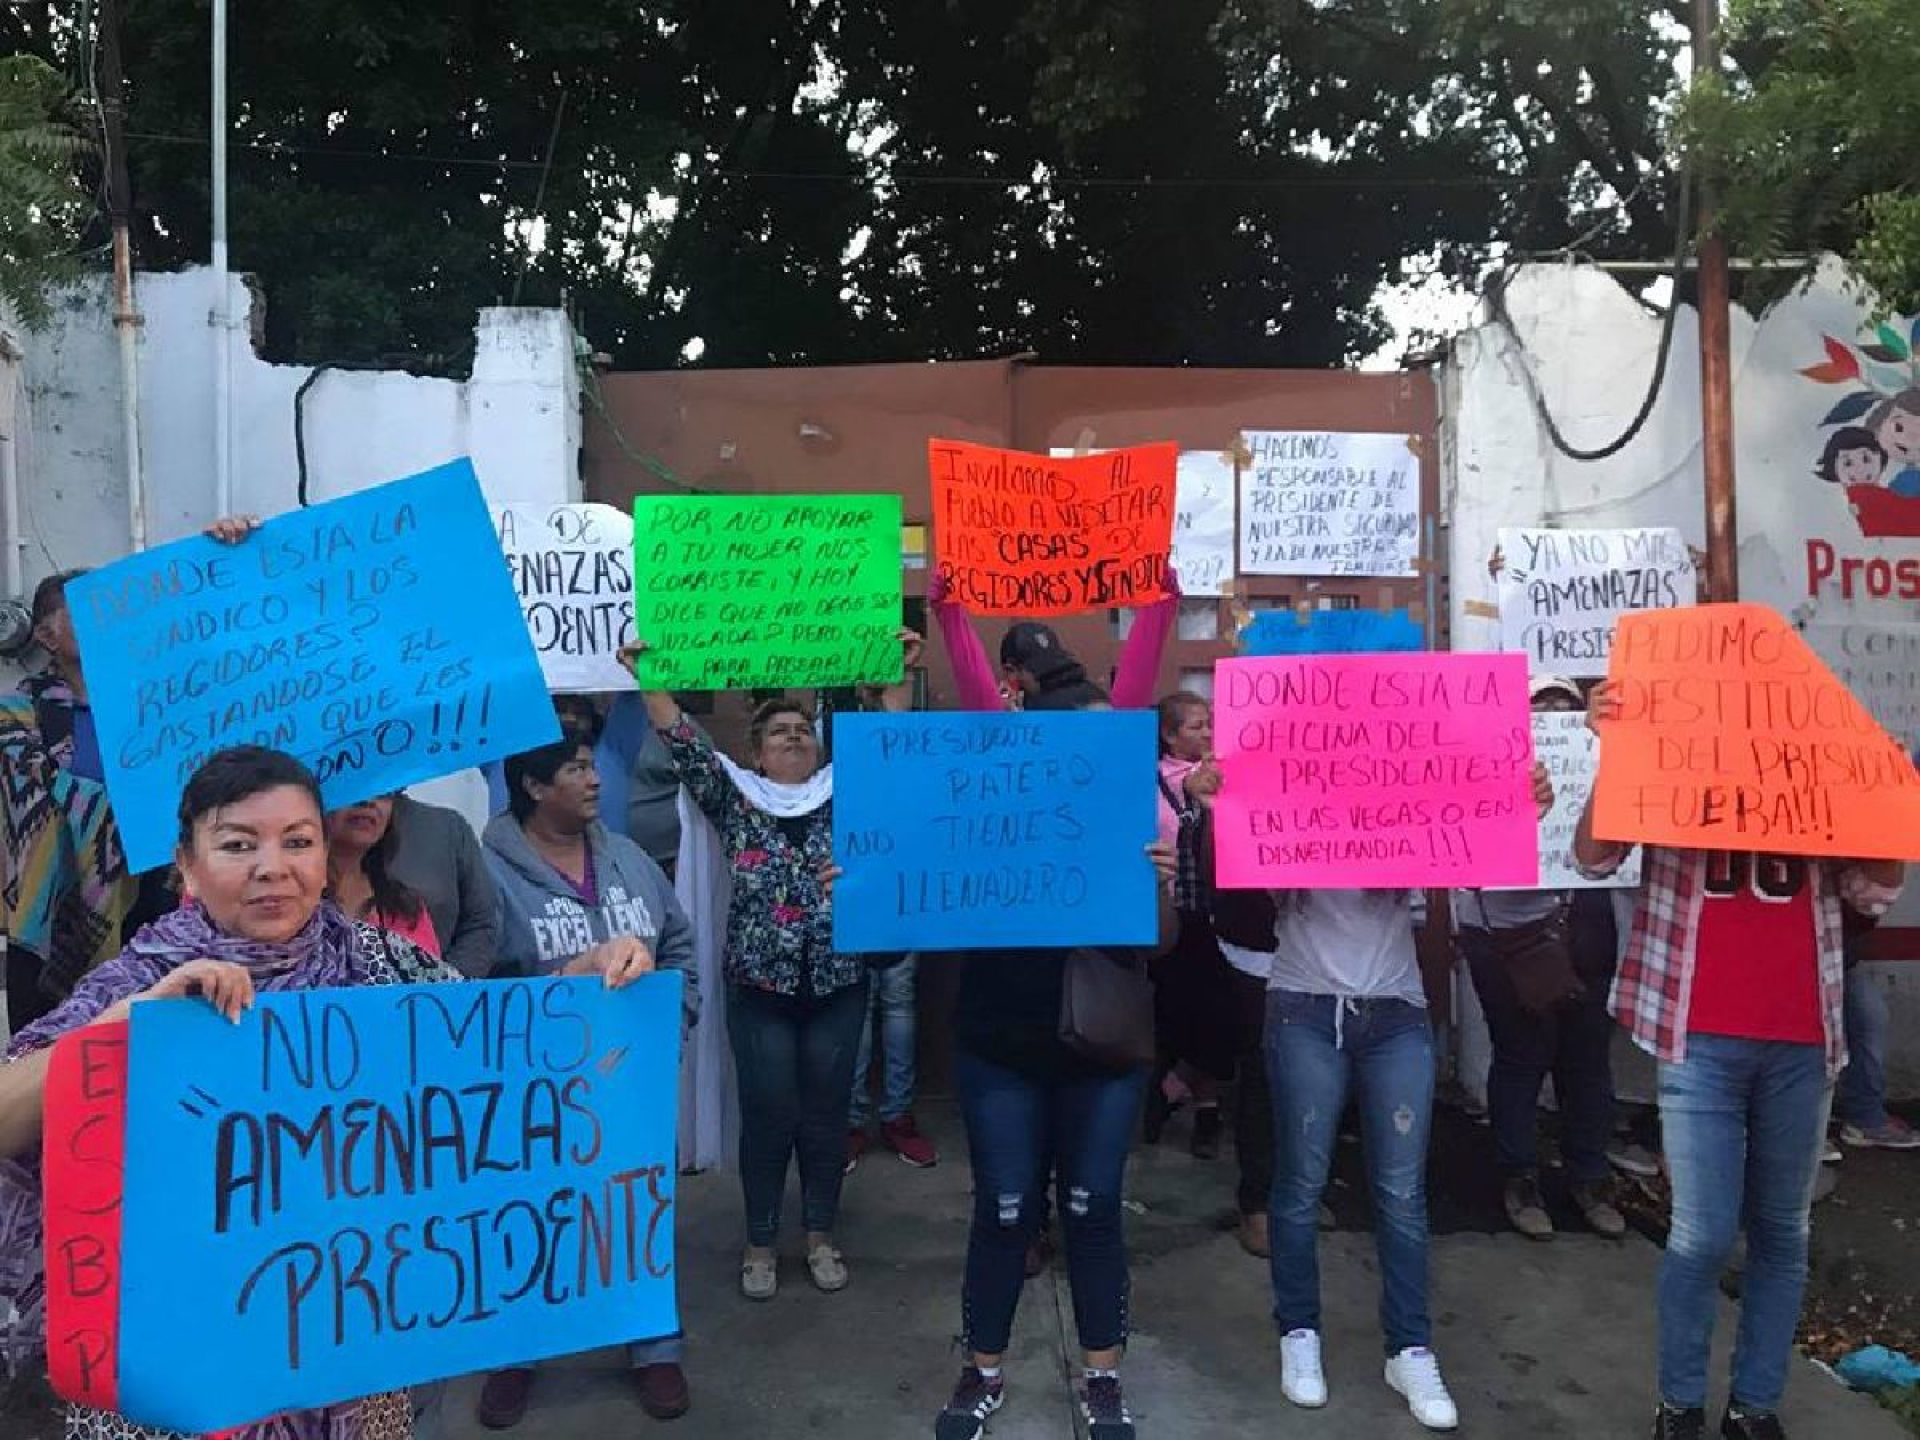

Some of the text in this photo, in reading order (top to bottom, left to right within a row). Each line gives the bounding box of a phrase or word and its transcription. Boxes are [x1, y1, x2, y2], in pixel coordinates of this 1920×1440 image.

[1253, 434, 1339, 460] HACEMOS
[1390, 470, 1408, 490] AL
[651, 503, 874, 534] POR NO APOYAR
[1030, 500, 1046, 528] A
[1250, 489, 1394, 513] PRESIDENTE DE
[371, 503, 417, 545] LA
[547, 506, 602, 545] DE
[1107, 526, 1147, 554] DE
[1249, 514, 1331, 542] NUESTRA
[652, 536, 871, 564] A TU MUJER NOS
[1522, 533, 1560, 570] YA
[1568, 533, 1609, 565] NO
[306, 577, 327, 616] Y
[348, 556, 419, 602] LOS
[808, 563, 858, 592] HOY
[652, 600, 708, 624] DICE
[719, 602, 768, 624] QUE
[774, 599, 807, 620] NO
[792, 624, 842, 646] PERO
[851, 623, 890, 642] QUE
[1229, 664, 1351, 710] DONDE
[1464, 671, 1503, 706] LA
[874, 724, 1044, 761] PRESIDENTE
[1238, 719, 1465, 752] OFICINA DEL
[1659, 735, 1728, 776] DEL
[846, 803, 1085, 856] NO TIENES
[1250, 798, 1513, 836] EN LAS VEGAS O EN
[897, 862, 1088, 917] LLENADERO
[260, 982, 594, 1092] NO MAS
[235, 1163, 673, 1370] PRESIDENTE
